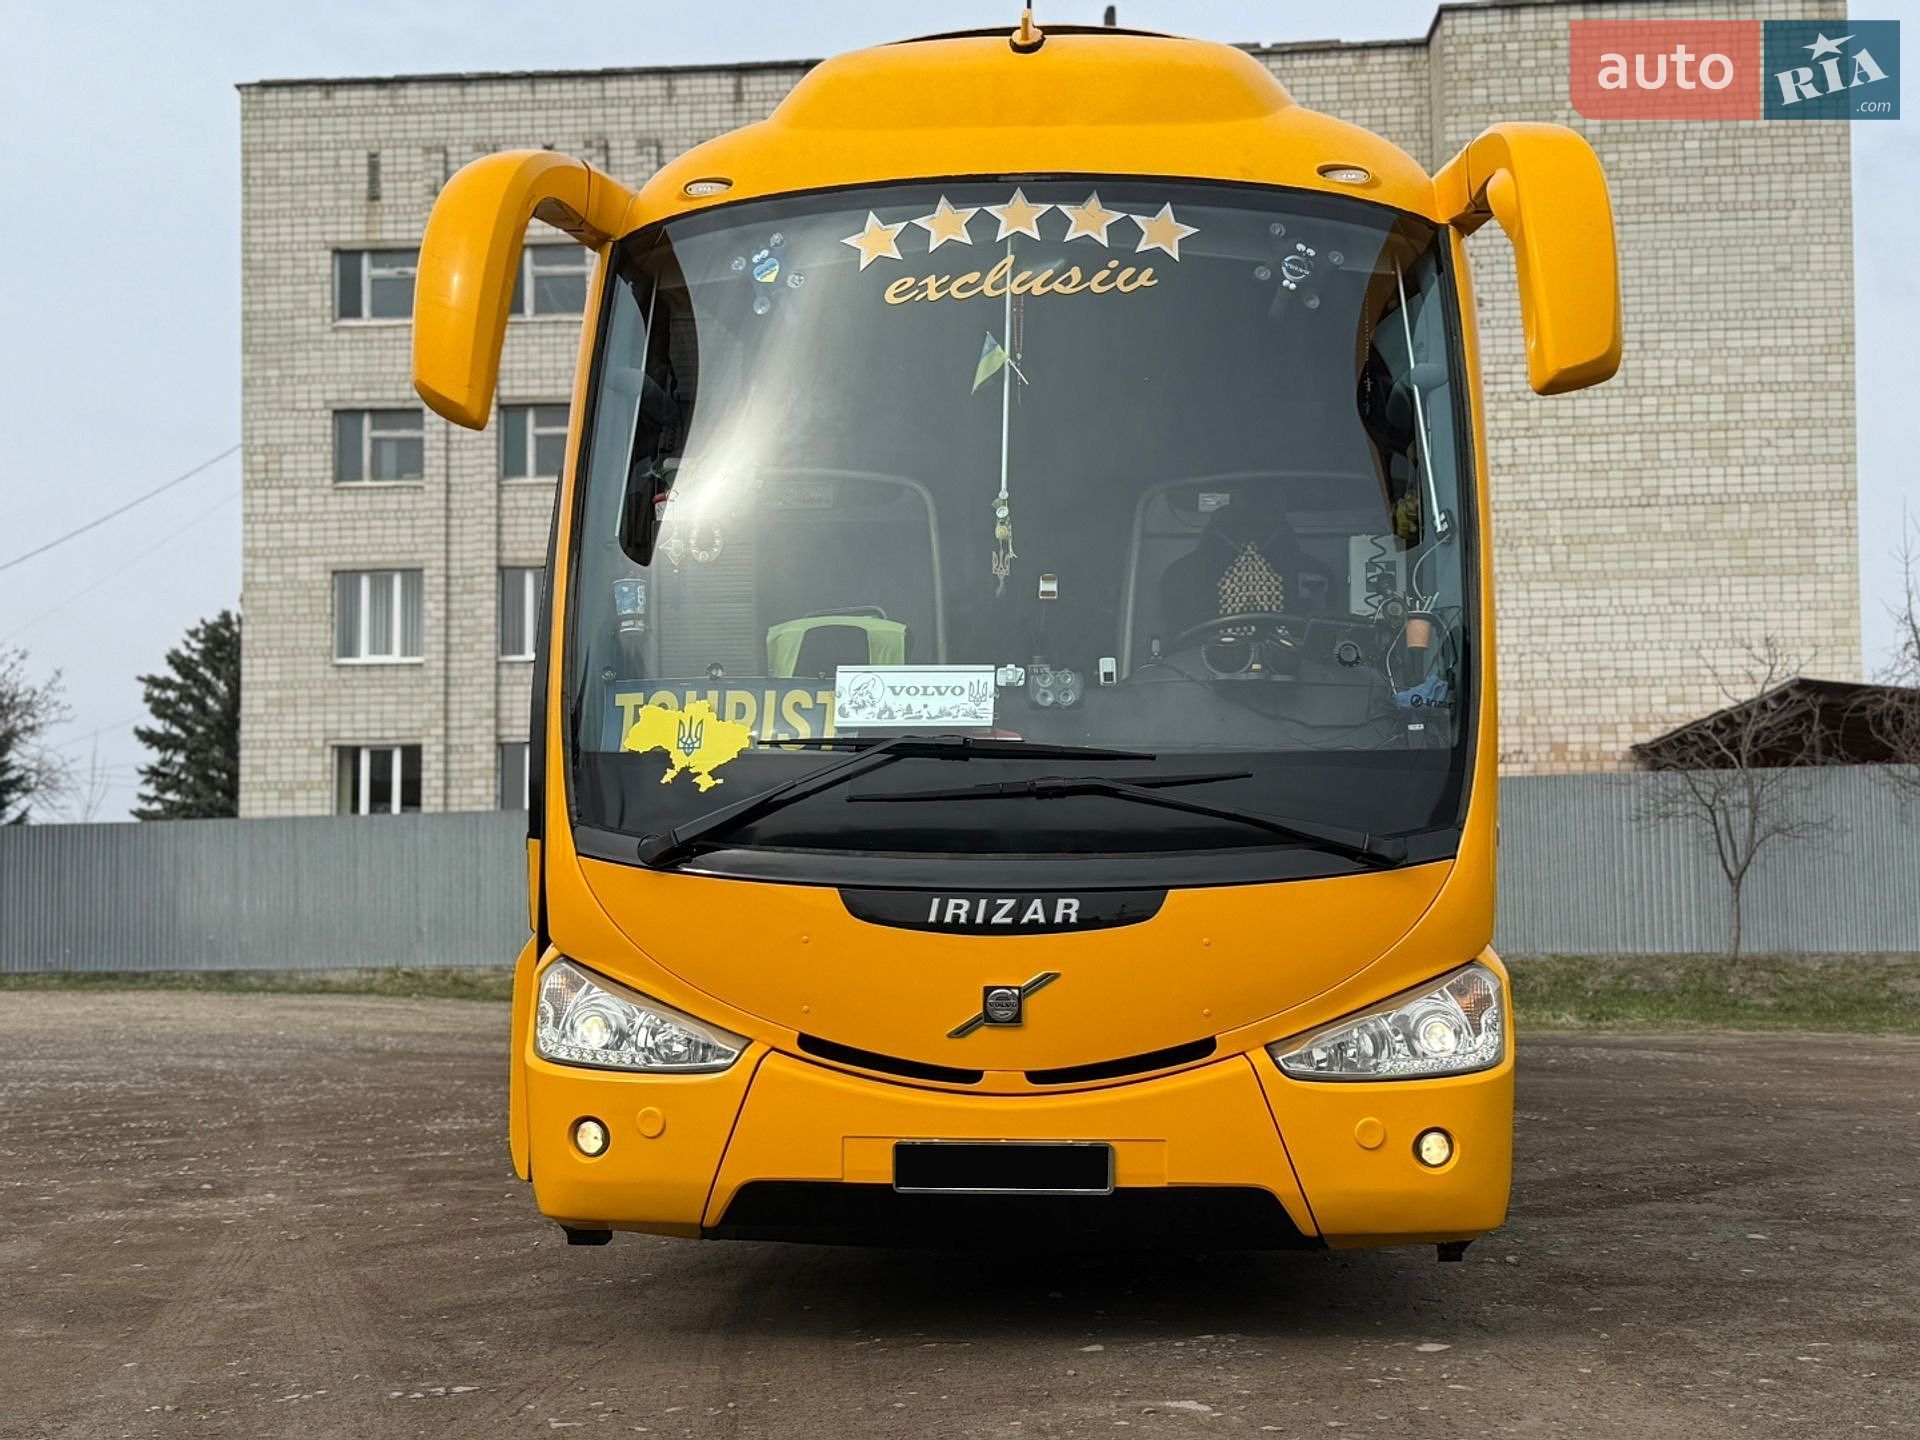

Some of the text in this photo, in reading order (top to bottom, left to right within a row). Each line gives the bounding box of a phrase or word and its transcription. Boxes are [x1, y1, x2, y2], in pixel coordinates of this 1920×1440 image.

[884, 255, 1159, 304] exclusiv
[887, 685, 966, 697] VOLVO
[927, 897, 1081, 925] IRIZAR
